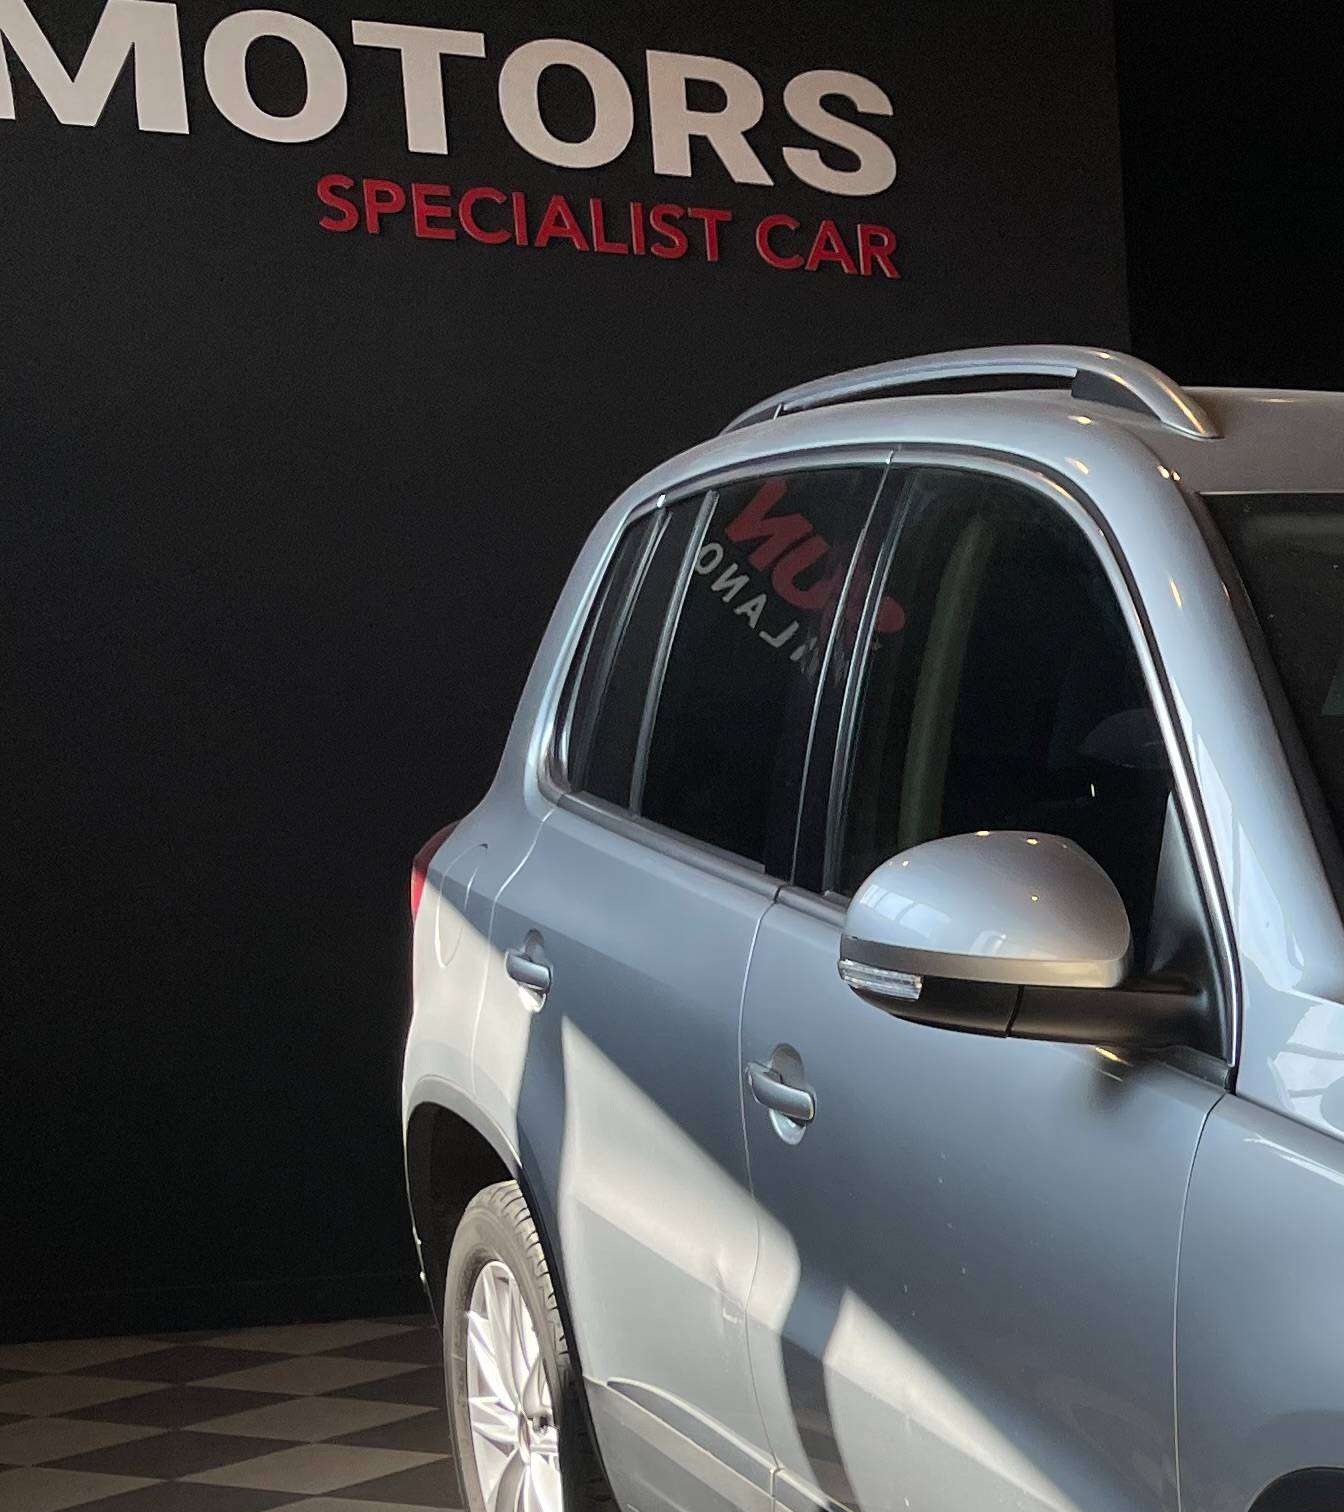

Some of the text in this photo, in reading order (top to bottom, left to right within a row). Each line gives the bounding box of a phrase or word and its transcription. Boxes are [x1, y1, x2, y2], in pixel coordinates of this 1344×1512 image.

[0, 0, 898, 197] MOTORS
[317, 173, 901, 281] SPECIALIST CAR
